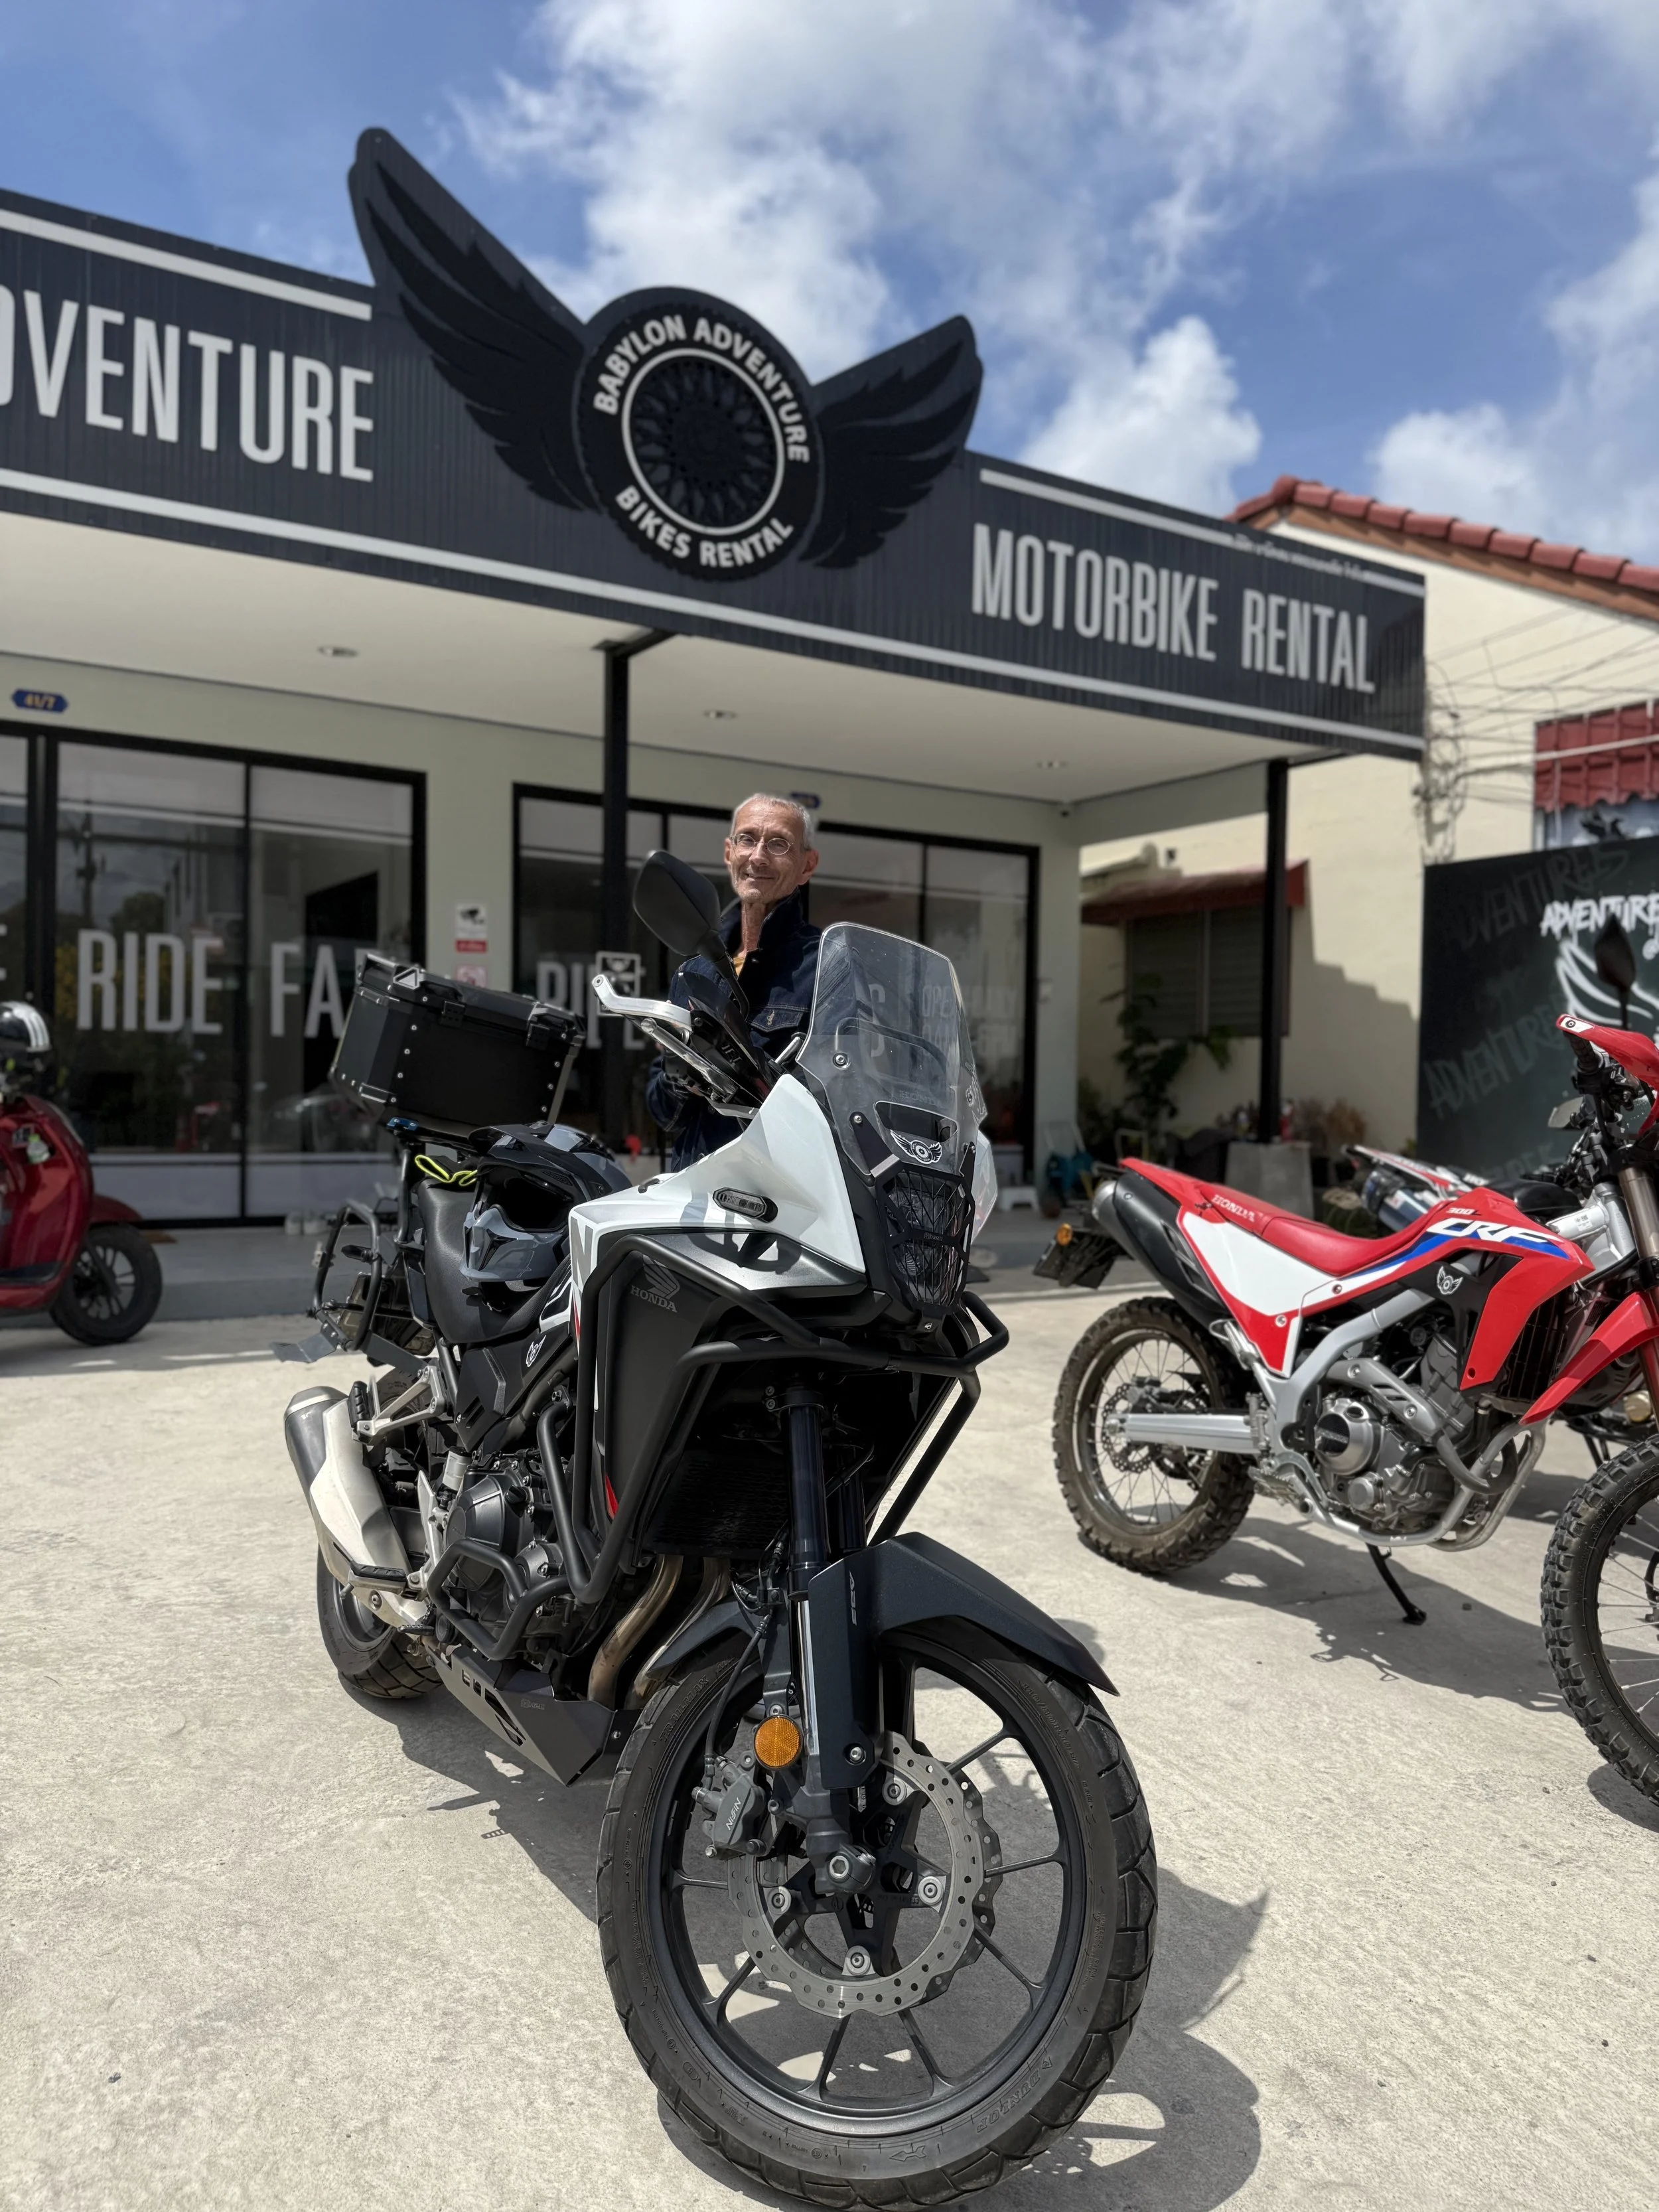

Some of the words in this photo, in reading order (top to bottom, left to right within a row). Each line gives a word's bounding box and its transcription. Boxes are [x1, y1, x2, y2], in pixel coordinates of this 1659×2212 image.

[593, 314, 687, 416] BABYLON
[693, 317, 810, 463] ADVENTURE
[615, 484, 692, 559] BIKES
[699, 517, 794, 569] RENTAL
[972, 523, 1218, 662] MOTORBIKE
[1241, 588, 1376, 694] RENTAL
[77, 928, 224, 1035] RIDE
[270, 942, 376, 1038] FA
[1212, 1194, 1256, 1222] HONDA
[1426, 1217, 1565, 1243] CRF
[630, 1284, 678, 1313] HONDA
[725, 1797, 741, 1831] NISSIN
[975, 2067, 1041, 2134] DUNLOP
